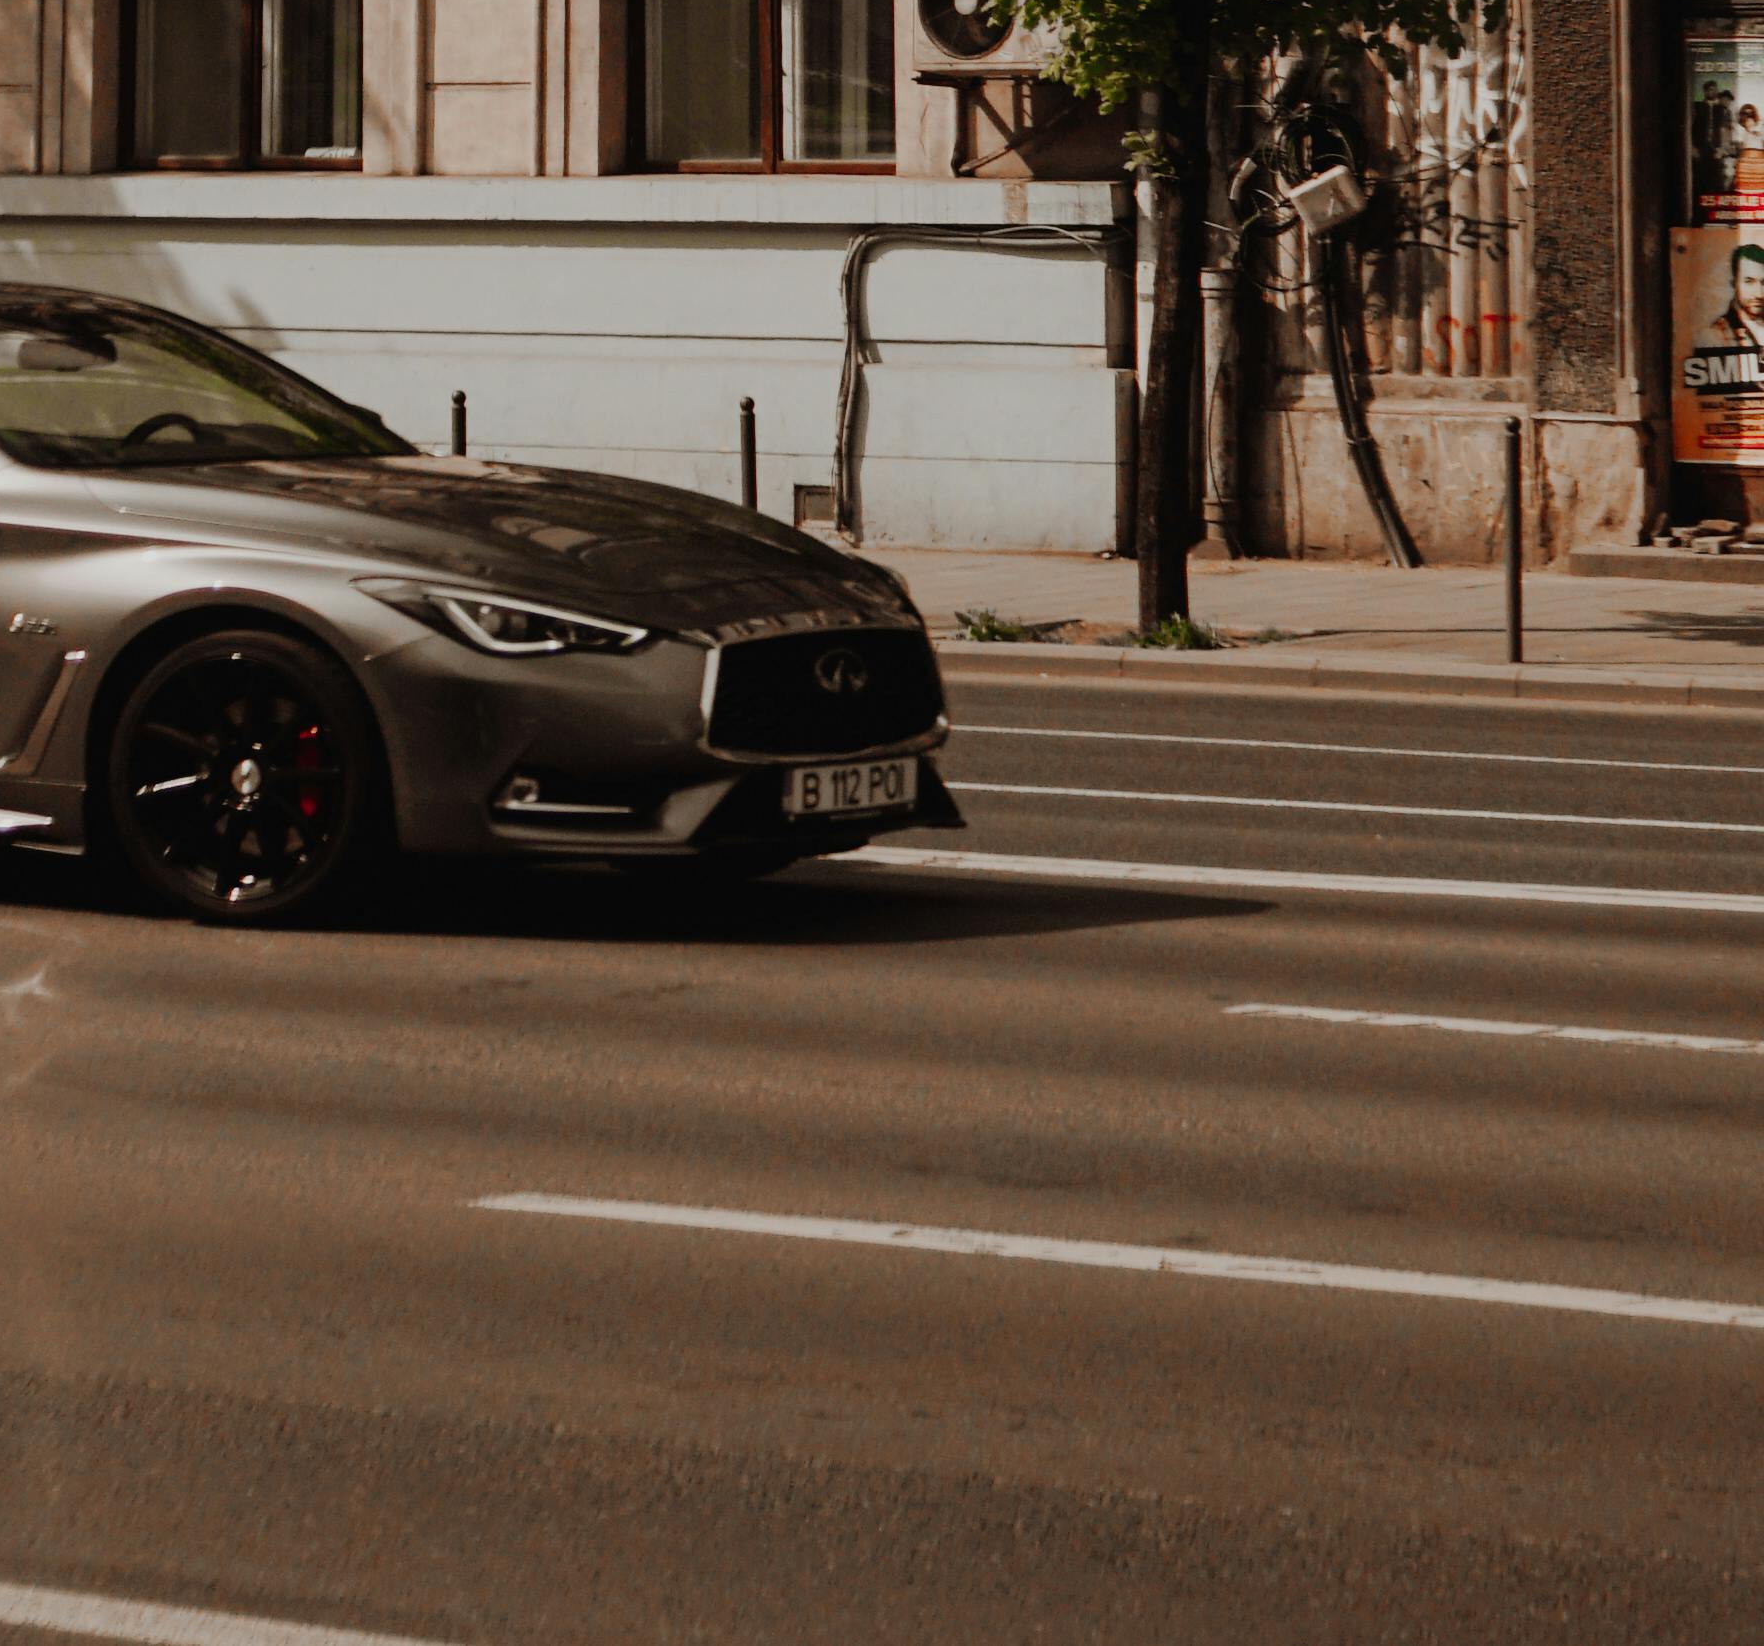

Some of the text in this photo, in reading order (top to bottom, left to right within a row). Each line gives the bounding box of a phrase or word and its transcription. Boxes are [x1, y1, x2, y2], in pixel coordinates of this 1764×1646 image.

[1683, 353, 1764, 387] SMIL
[803, 772, 819, 809] B
[832, 767, 861, 806] 112
